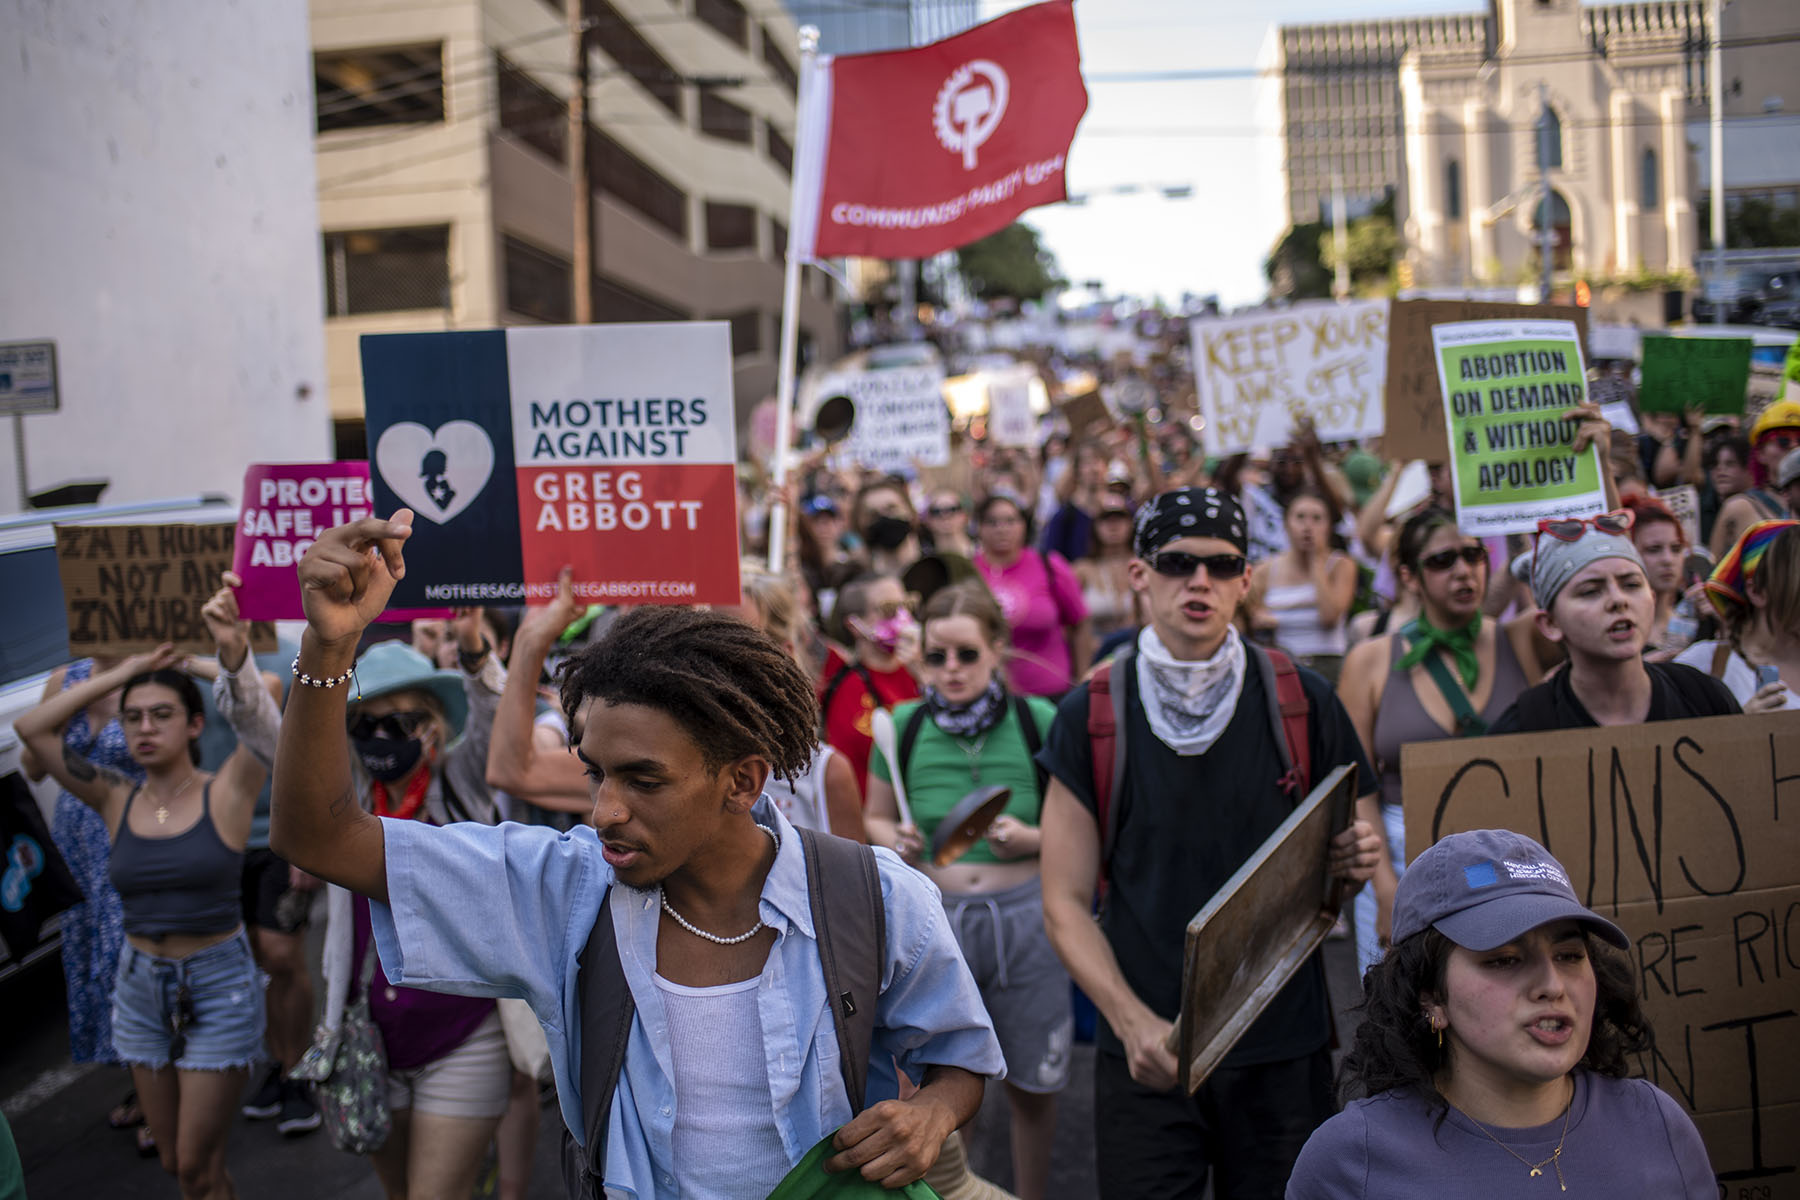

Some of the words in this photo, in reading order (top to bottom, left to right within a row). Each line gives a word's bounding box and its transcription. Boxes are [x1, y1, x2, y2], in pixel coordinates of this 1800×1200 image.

[1204, 320, 1298, 377] KEEP
[1304, 308, 1384, 357] YOUR
[1460, 350, 1567, 381] ABORTION
[531, 399, 707, 428] MOTHERS
[1453, 391, 1482, 418] ON
[1490, 383, 1583, 412] DEMAND
[532, 430, 690, 459] AGAINST
[1464, 430, 1478, 453] &
[534, 472, 643, 501] GREG
[1479, 456, 1577, 490] APOLOGY
[243, 508, 325, 539] SAFE,
[536, 501, 703, 531] ABBOTT
[127, 527, 148, 557] A
[98, 562, 169, 596] NOT
[181, 560, 224, 596] AN
[425, 581, 696, 600] MOTHERSAGAINSTREGABBOTT.COM
[1635, 1024, 1696, 1111] N
